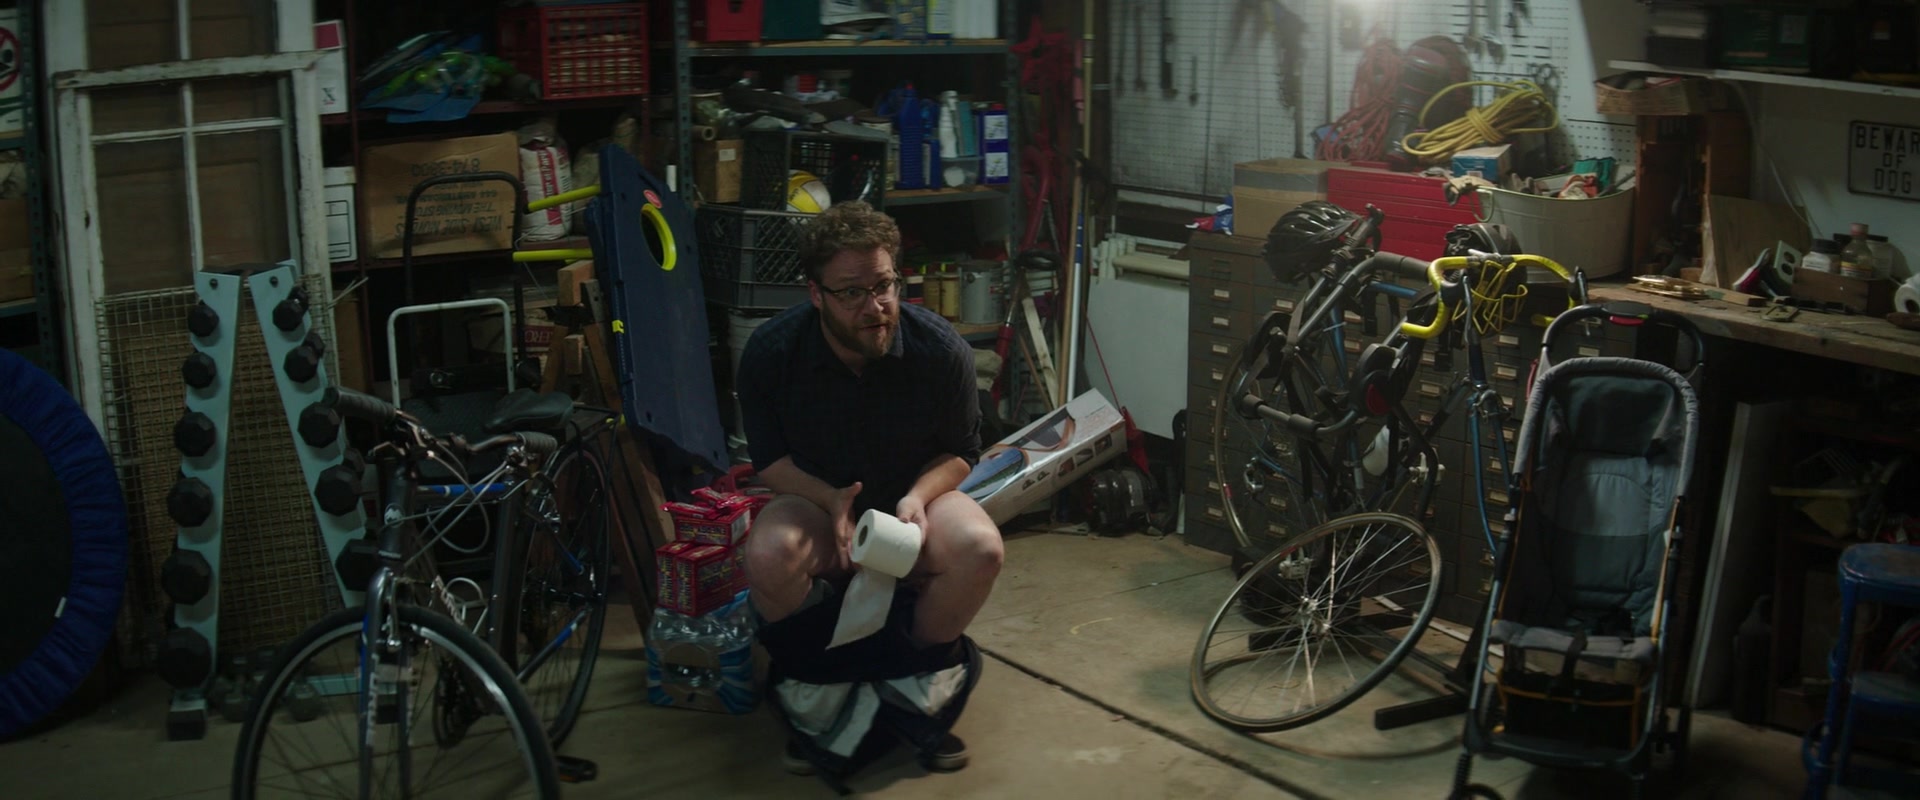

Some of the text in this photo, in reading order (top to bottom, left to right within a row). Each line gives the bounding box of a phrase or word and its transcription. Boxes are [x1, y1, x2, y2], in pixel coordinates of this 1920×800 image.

[1855, 125, 1920, 154] BEWAR
[1882, 152, 1906, 169] OF
[1874, 168, 1912, 194] DOG
